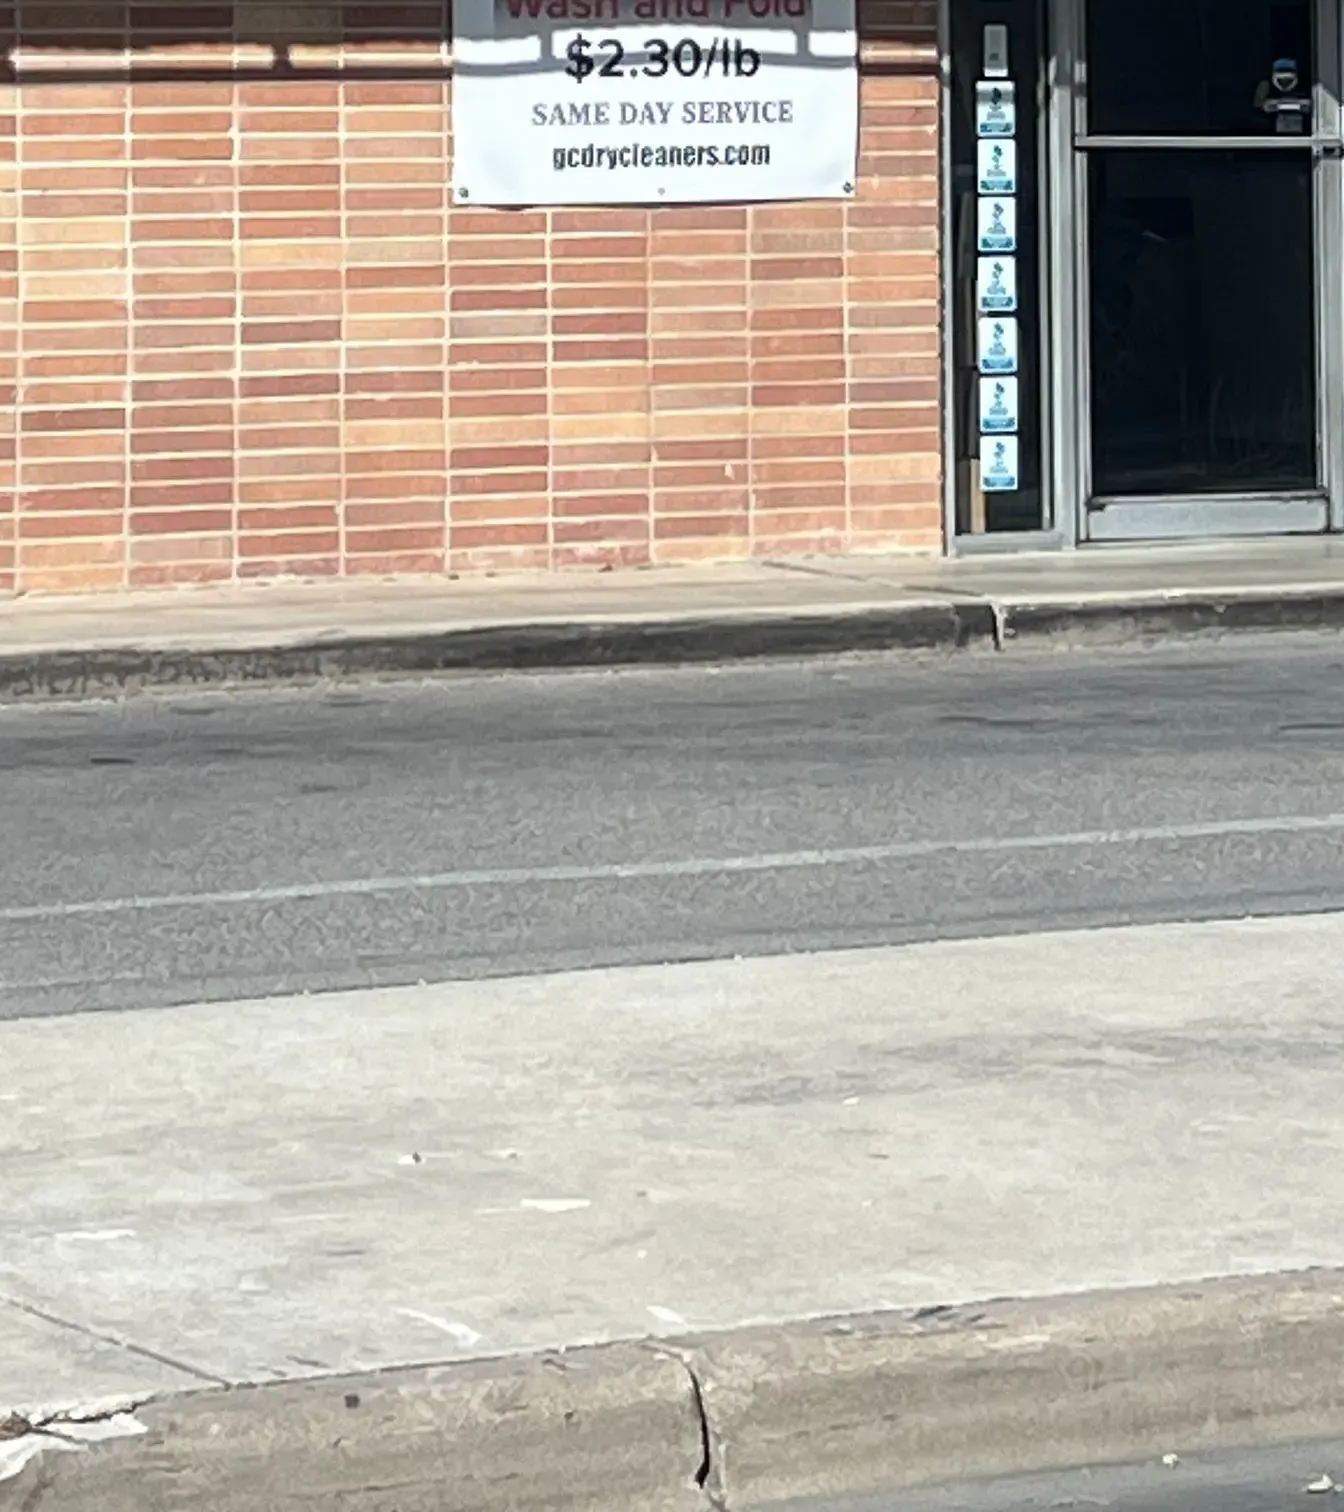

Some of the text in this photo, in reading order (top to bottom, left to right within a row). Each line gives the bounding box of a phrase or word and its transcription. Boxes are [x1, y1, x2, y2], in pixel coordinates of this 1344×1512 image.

[565, 32, 761, 84] $2.30/lb
[531, 99, 793, 126] SAME DAY SERVICE
[552, 143, 770, 171] gcdrycleaners.com
